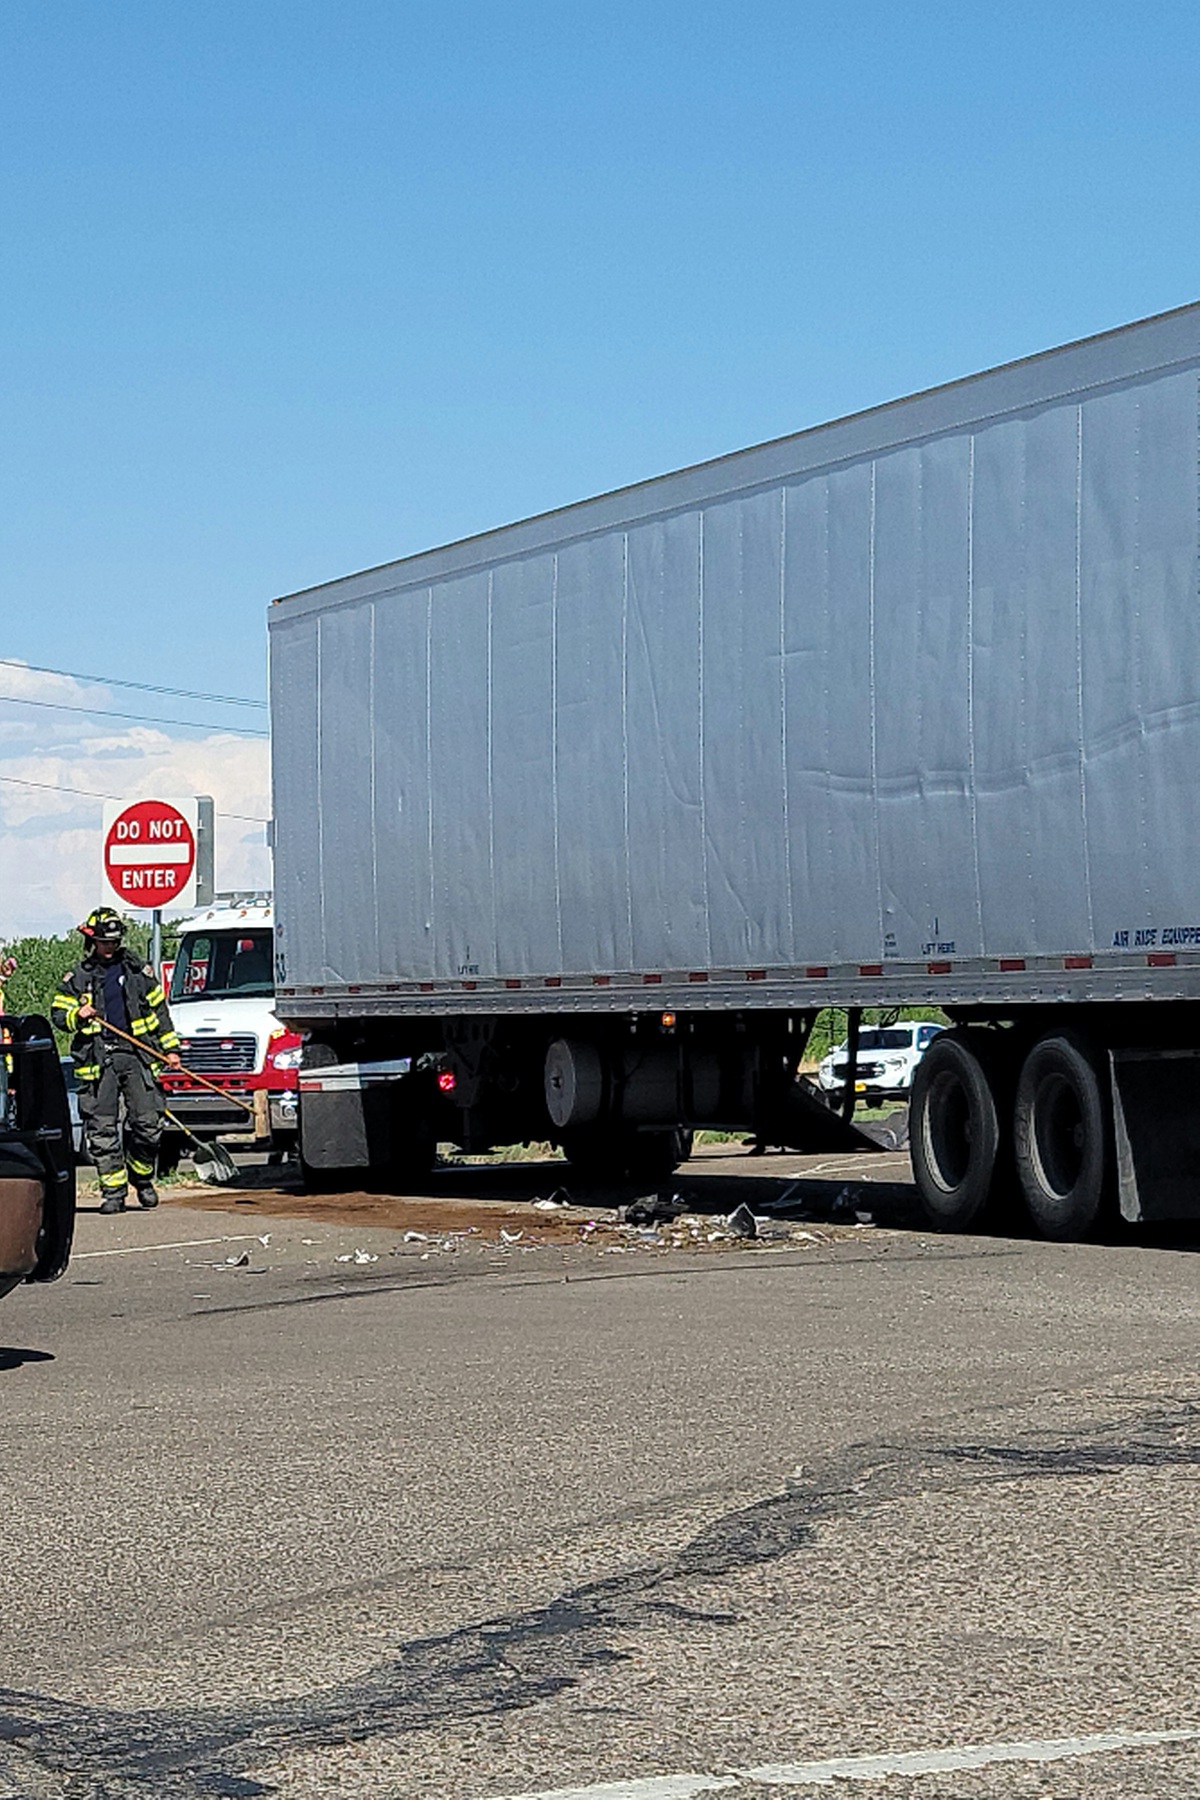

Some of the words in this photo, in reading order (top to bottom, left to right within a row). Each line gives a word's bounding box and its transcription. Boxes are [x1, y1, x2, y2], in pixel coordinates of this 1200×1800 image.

[117, 822, 140, 839] DO
[149, 820, 184, 839] NOT
[122, 870, 176, 889] ENTER
[1113, 930, 1129, 947] AIR
